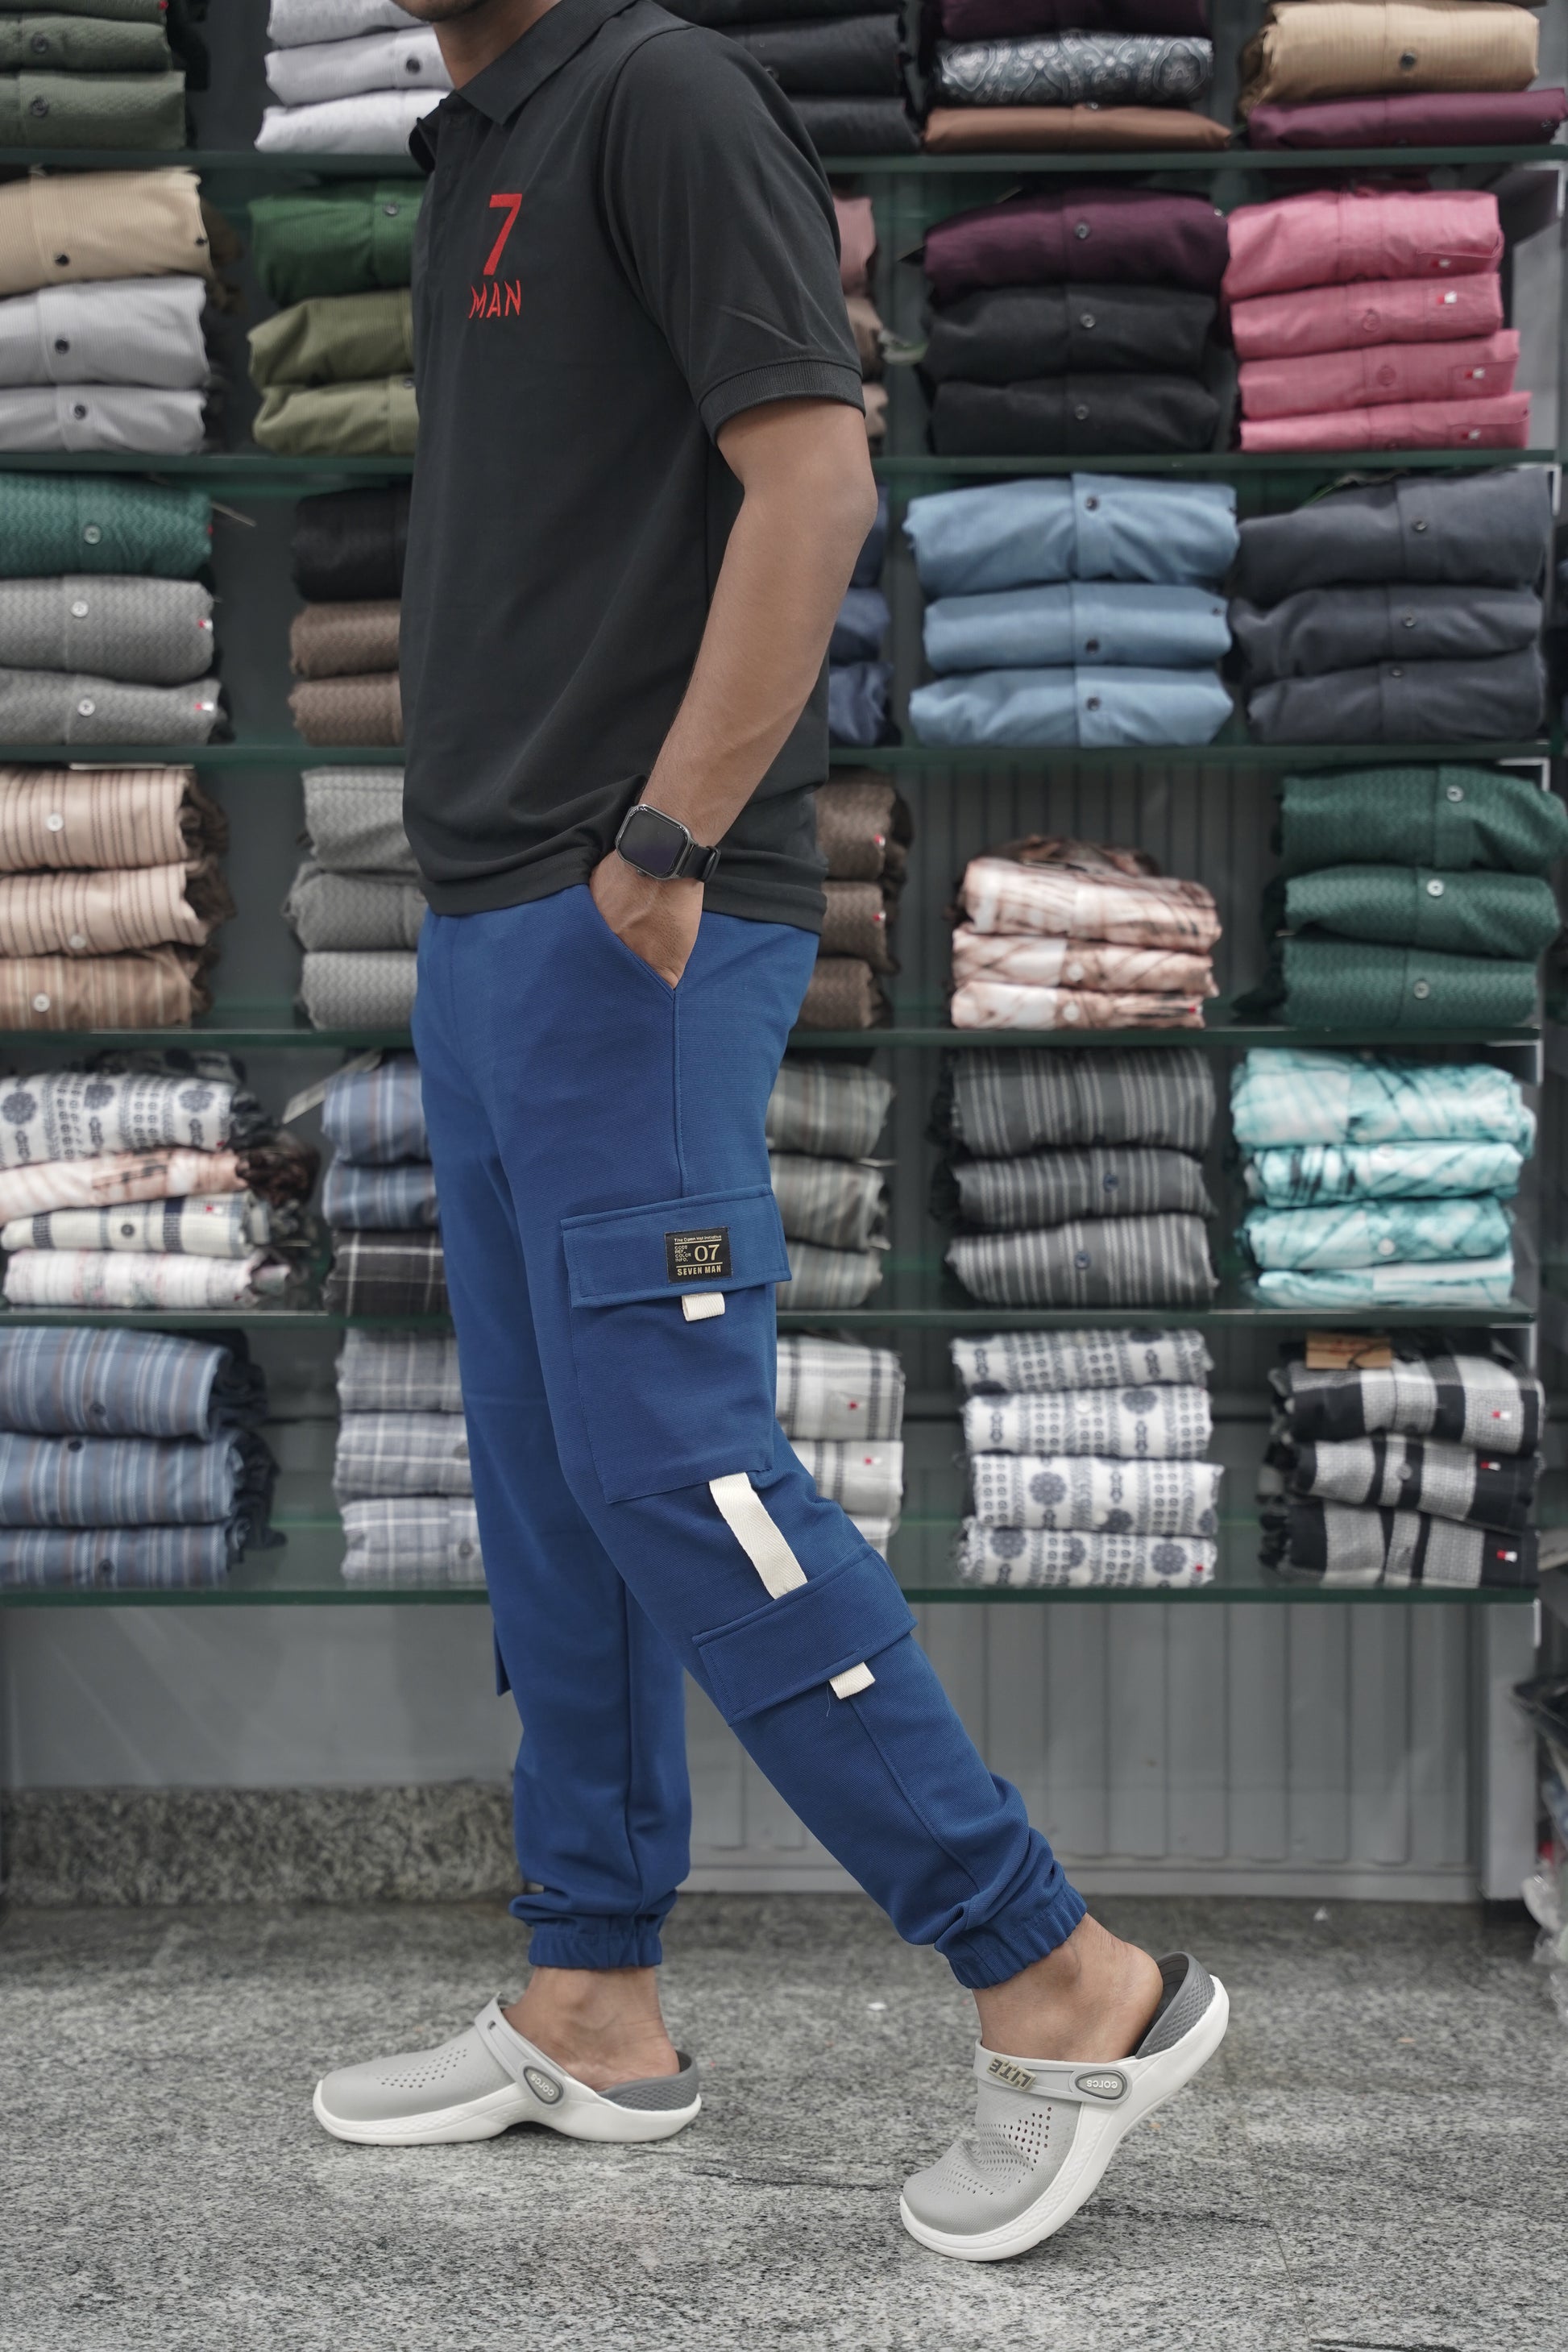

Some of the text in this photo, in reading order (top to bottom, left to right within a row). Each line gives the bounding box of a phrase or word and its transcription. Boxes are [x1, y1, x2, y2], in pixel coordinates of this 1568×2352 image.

[483, 193, 523, 276] 7
[469, 280, 521, 319] MAN
[695, 1244, 720, 1262] 07
[677, 1265, 721, 1276] SEVEN MAN
[989, 2058, 1032, 2088] LITE
